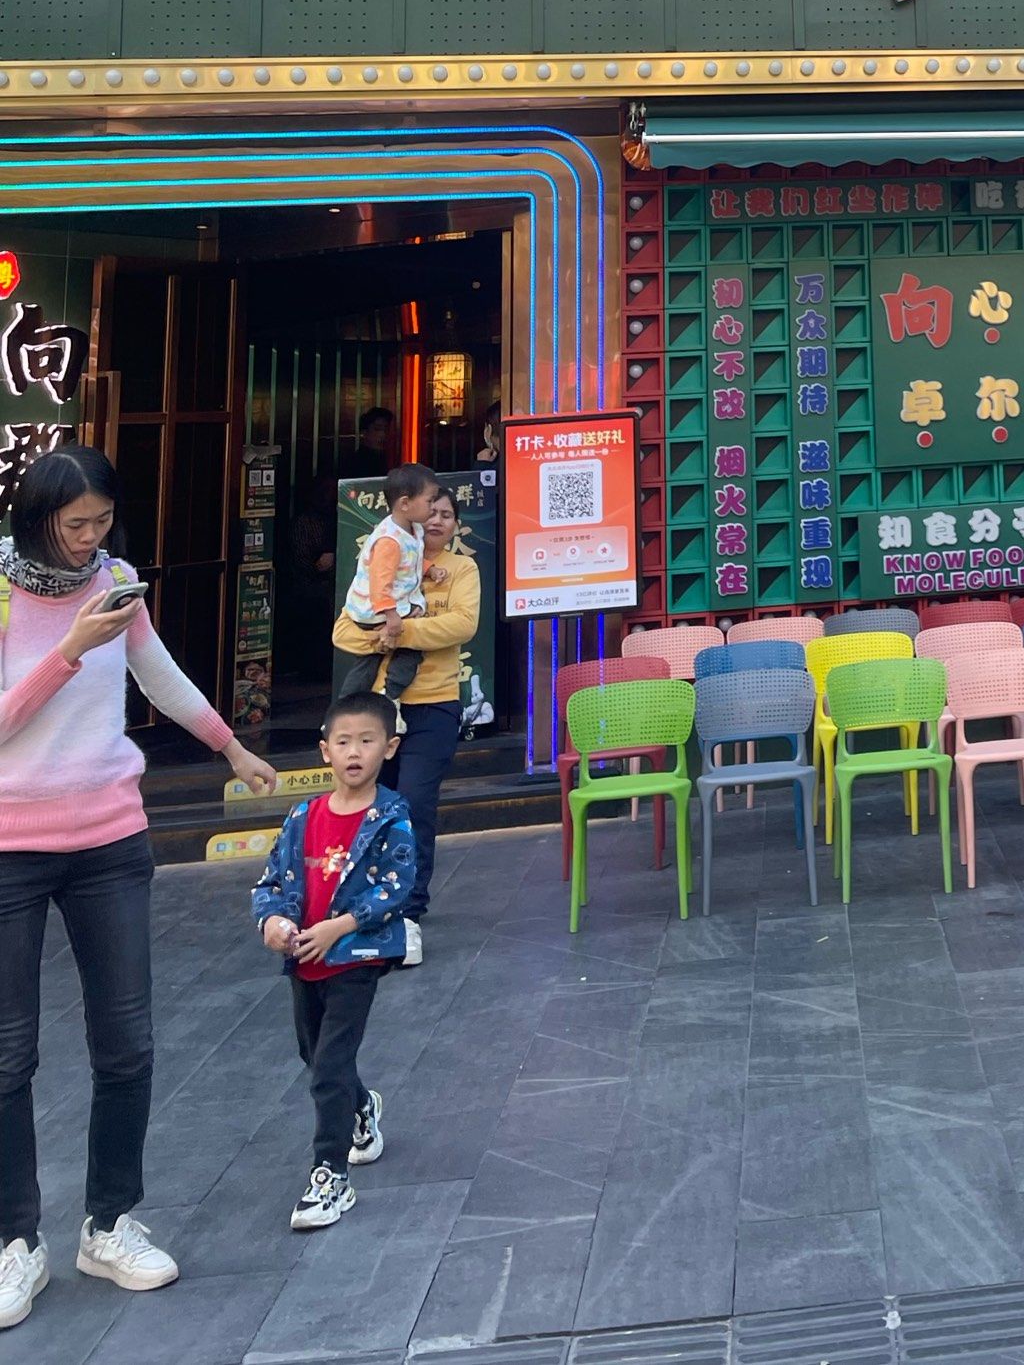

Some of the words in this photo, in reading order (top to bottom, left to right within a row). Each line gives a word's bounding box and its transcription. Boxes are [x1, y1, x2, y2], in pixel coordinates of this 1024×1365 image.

[710, 182, 944, 219] 让我们红尘作伴
[711, 277, 747, 421] 初心不改
[795, 273, 829, 415] 万众期待
[713, 444, 750, 597] 烟火常在
[798, 440, 833, 590] 滋味重现
[527, 596, 560, 609] 大众点评
[883, 550, 966, 575] KNOW
[286, 771, 334, 787] 小心台阶
